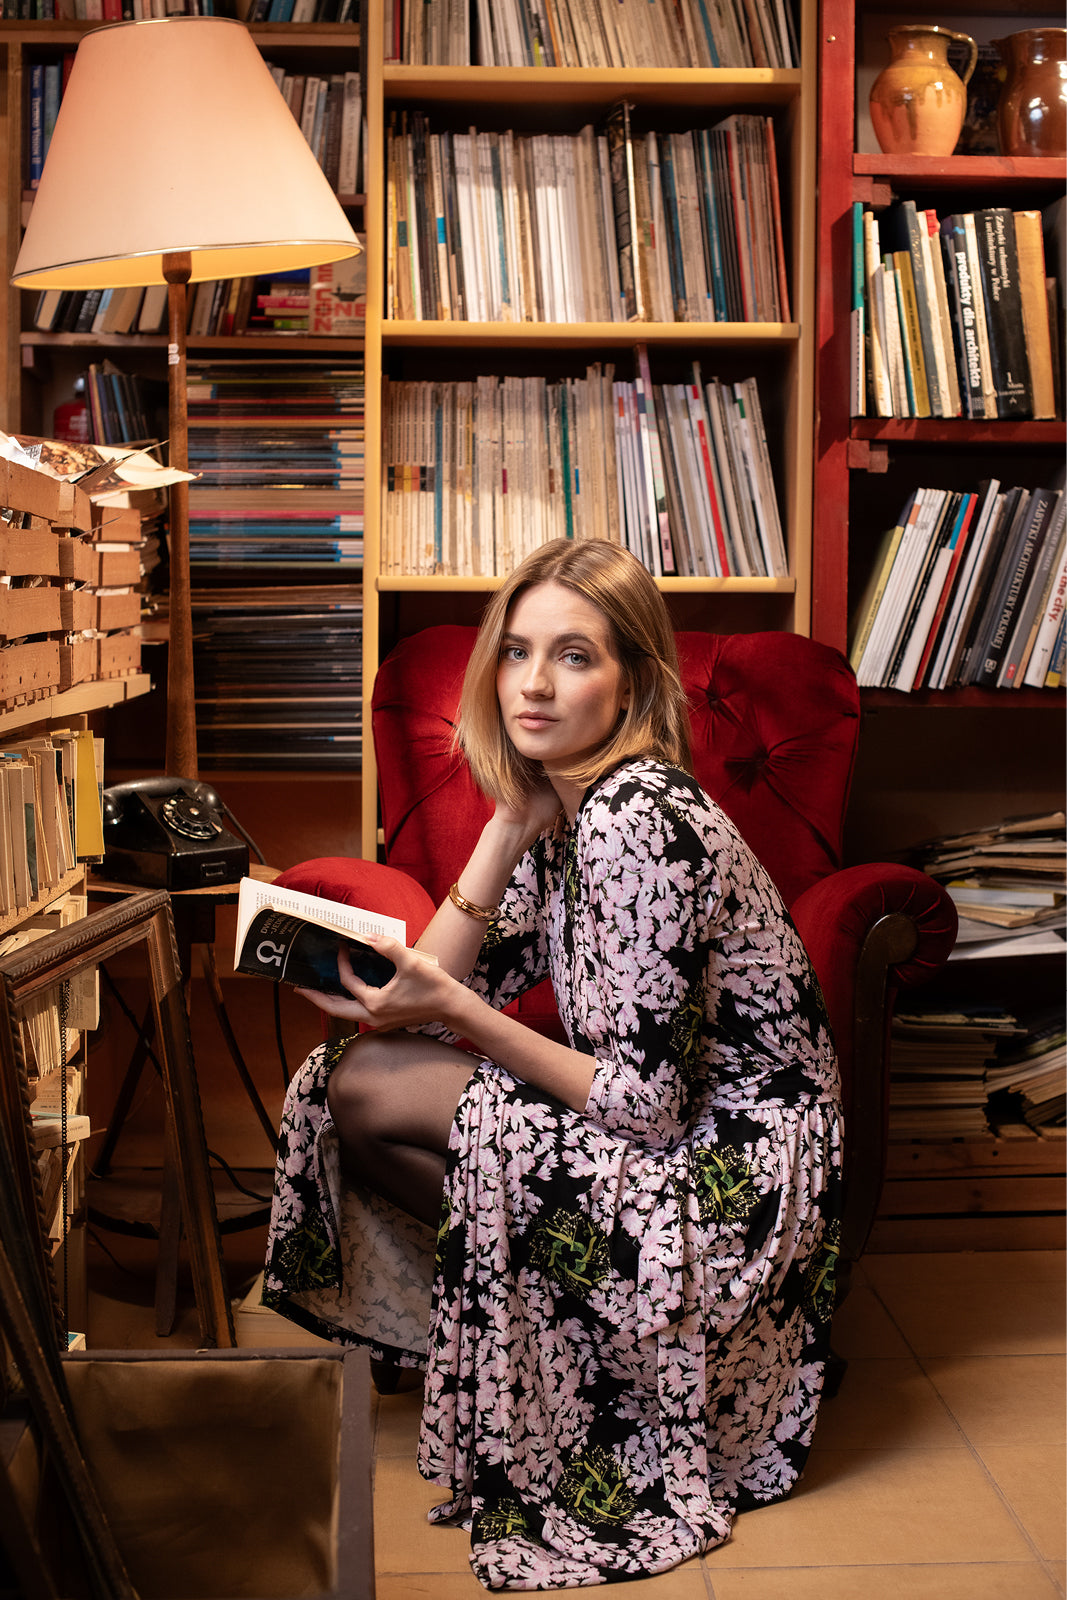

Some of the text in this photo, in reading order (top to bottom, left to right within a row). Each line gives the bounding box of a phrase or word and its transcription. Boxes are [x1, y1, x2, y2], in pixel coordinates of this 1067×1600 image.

[985, 221, 997, 267] architektury
[994, 216, 1006, 245] Zabytki
[955, 252, 972, 305] produkty
[962, 307, 975, 327] dla
[965, 328, 981, 388] architekta
[1027, 499, 1049, 541] ZABYTKI
[1004, 538, 1035, 607] ARCHITEKTURY
[991, 608, 1013, 650] POLSKIEJ
[1047, 597, 1063, 623] city.
